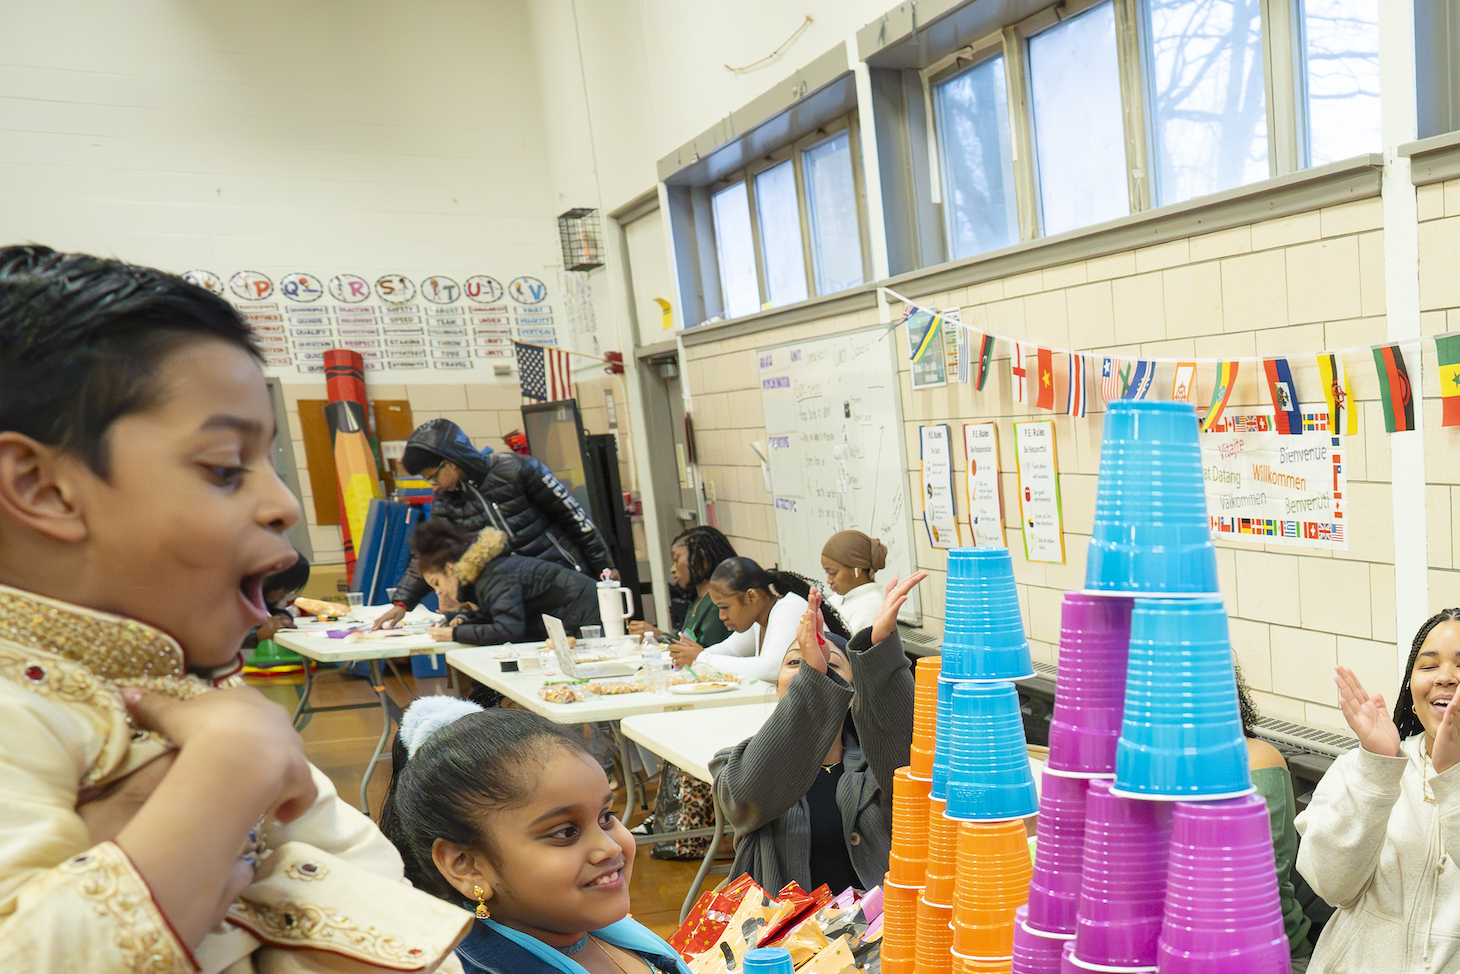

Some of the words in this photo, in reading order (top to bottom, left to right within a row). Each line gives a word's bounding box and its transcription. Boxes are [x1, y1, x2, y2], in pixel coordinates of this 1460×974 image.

[253, 281, 270, 297] P
[284, 281, 299, 297] Q
[348, 281, 365, 296] R
[379, 279, 395, 295] S
[443, 285, 456, 300] T
[468, 282, 481, 297] U
[529, 283, 542, 300] V
[1218, 438, 1245, 460] Vitajte
[1279, 446, 1327, 464] Bienvenue
[1212, 465, 1242, 489] Datang
[1252, 463, 1307, 491] Willkommen
[1285, 491, 1330, 515] Benvenuti
